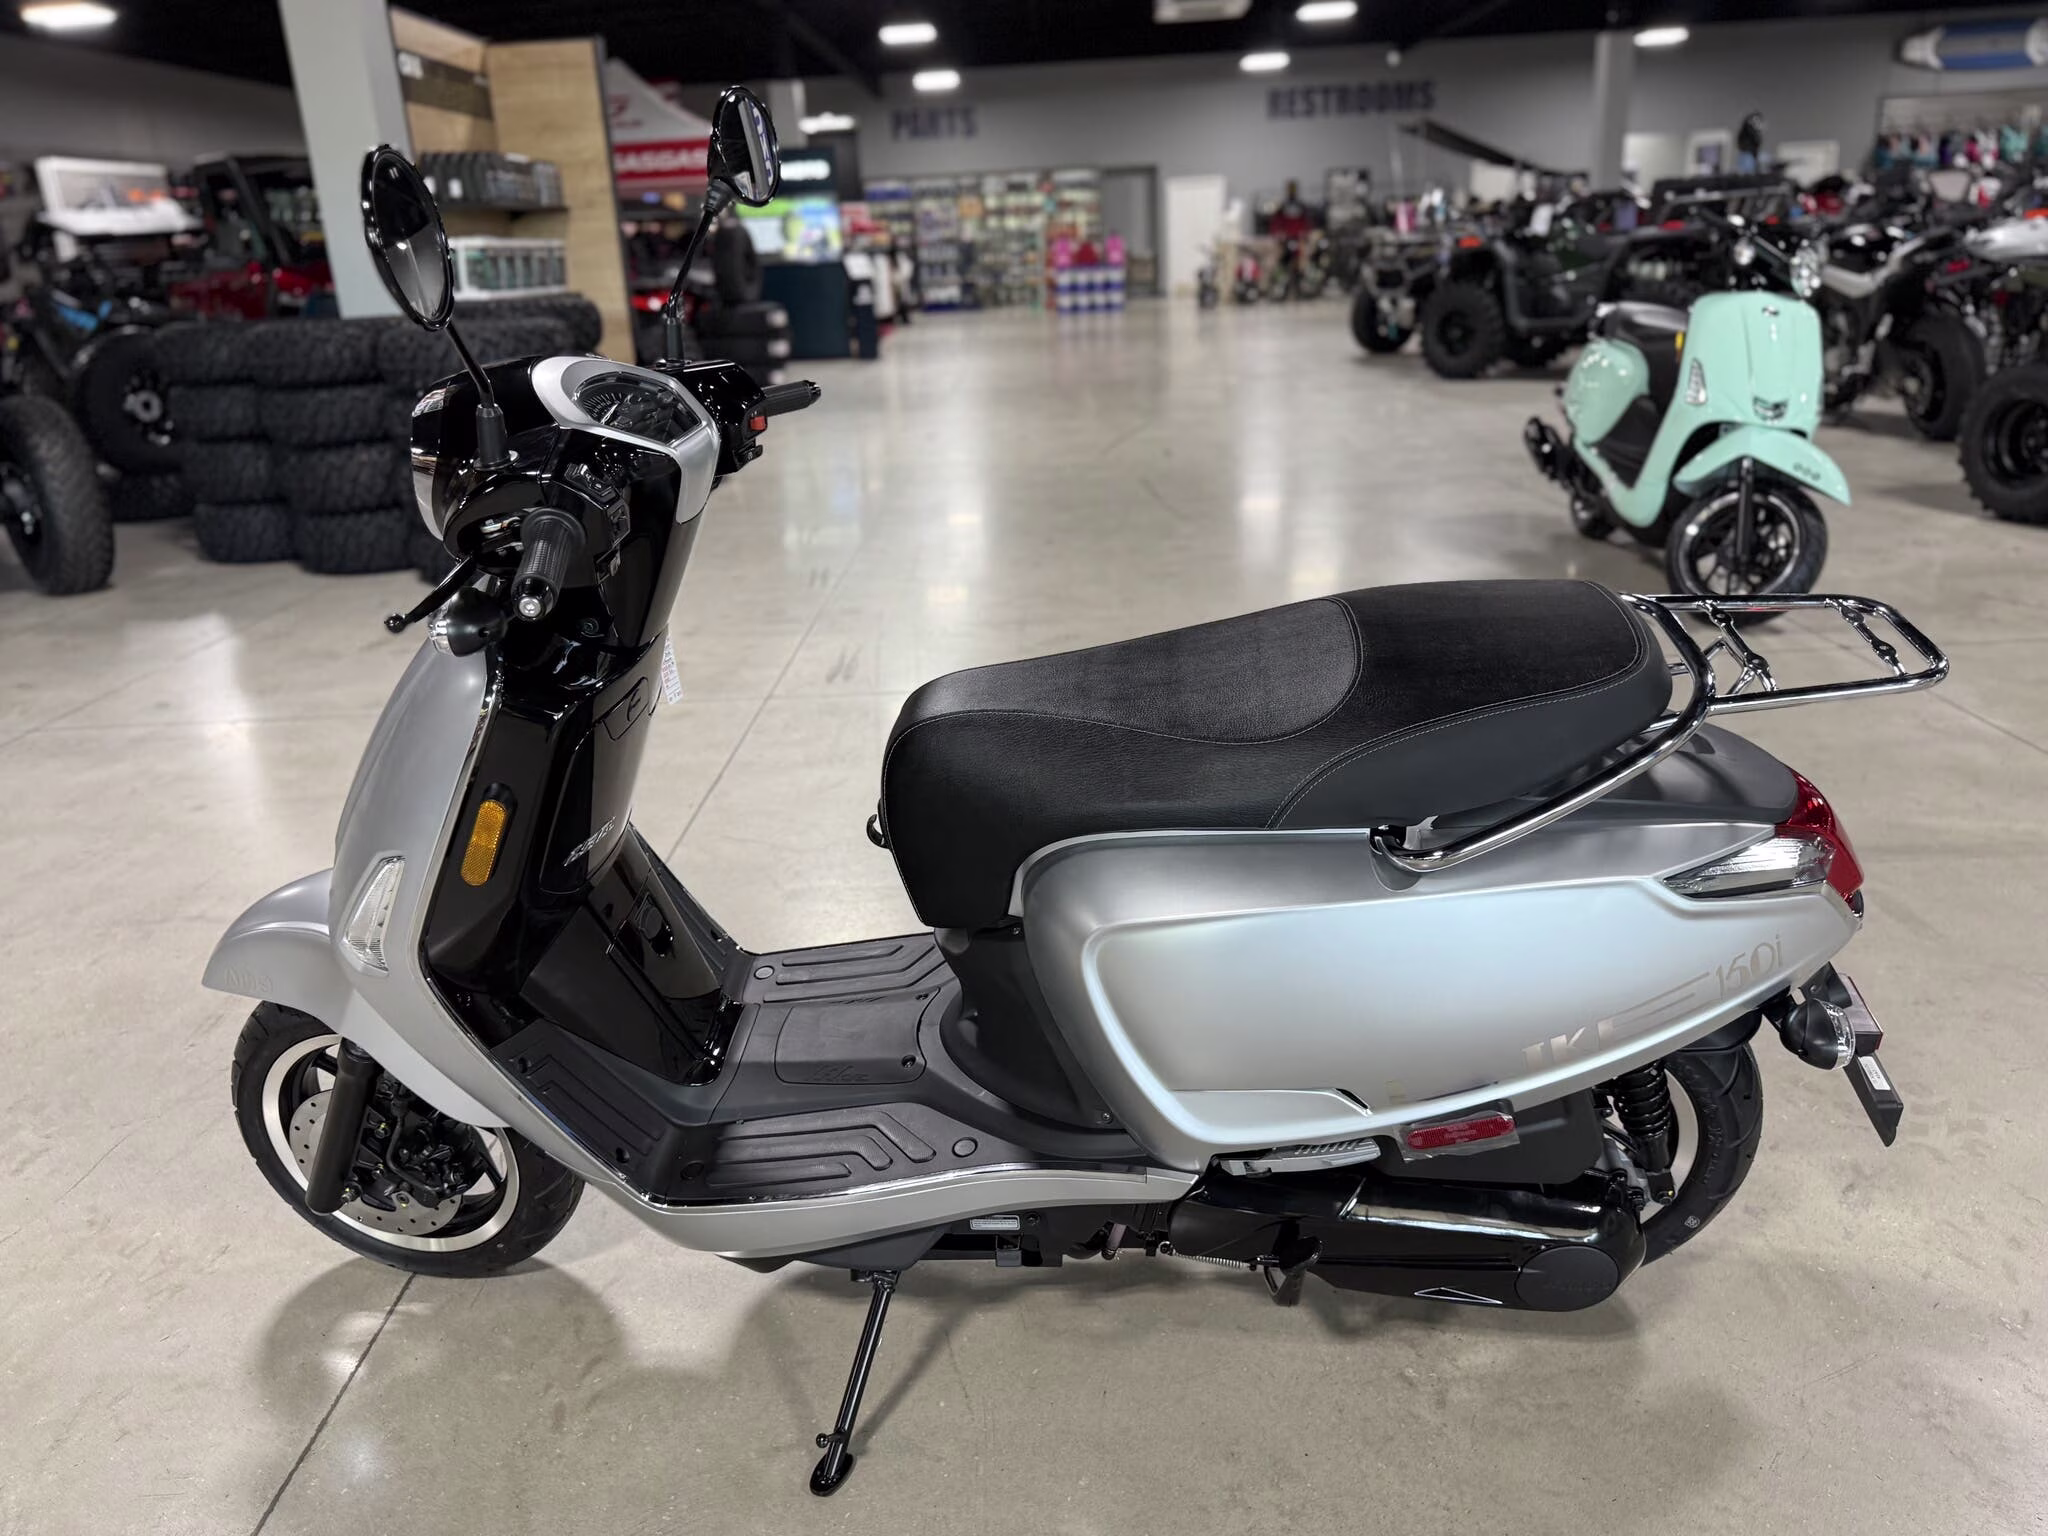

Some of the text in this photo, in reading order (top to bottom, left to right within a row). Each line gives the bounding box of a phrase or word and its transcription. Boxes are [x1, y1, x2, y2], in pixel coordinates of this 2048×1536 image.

[1267, 82, 1436, 119] RESTROOMS
[890, 107, 978, 142] PARTS
[1716, 933, 1783, 1000] 150i
